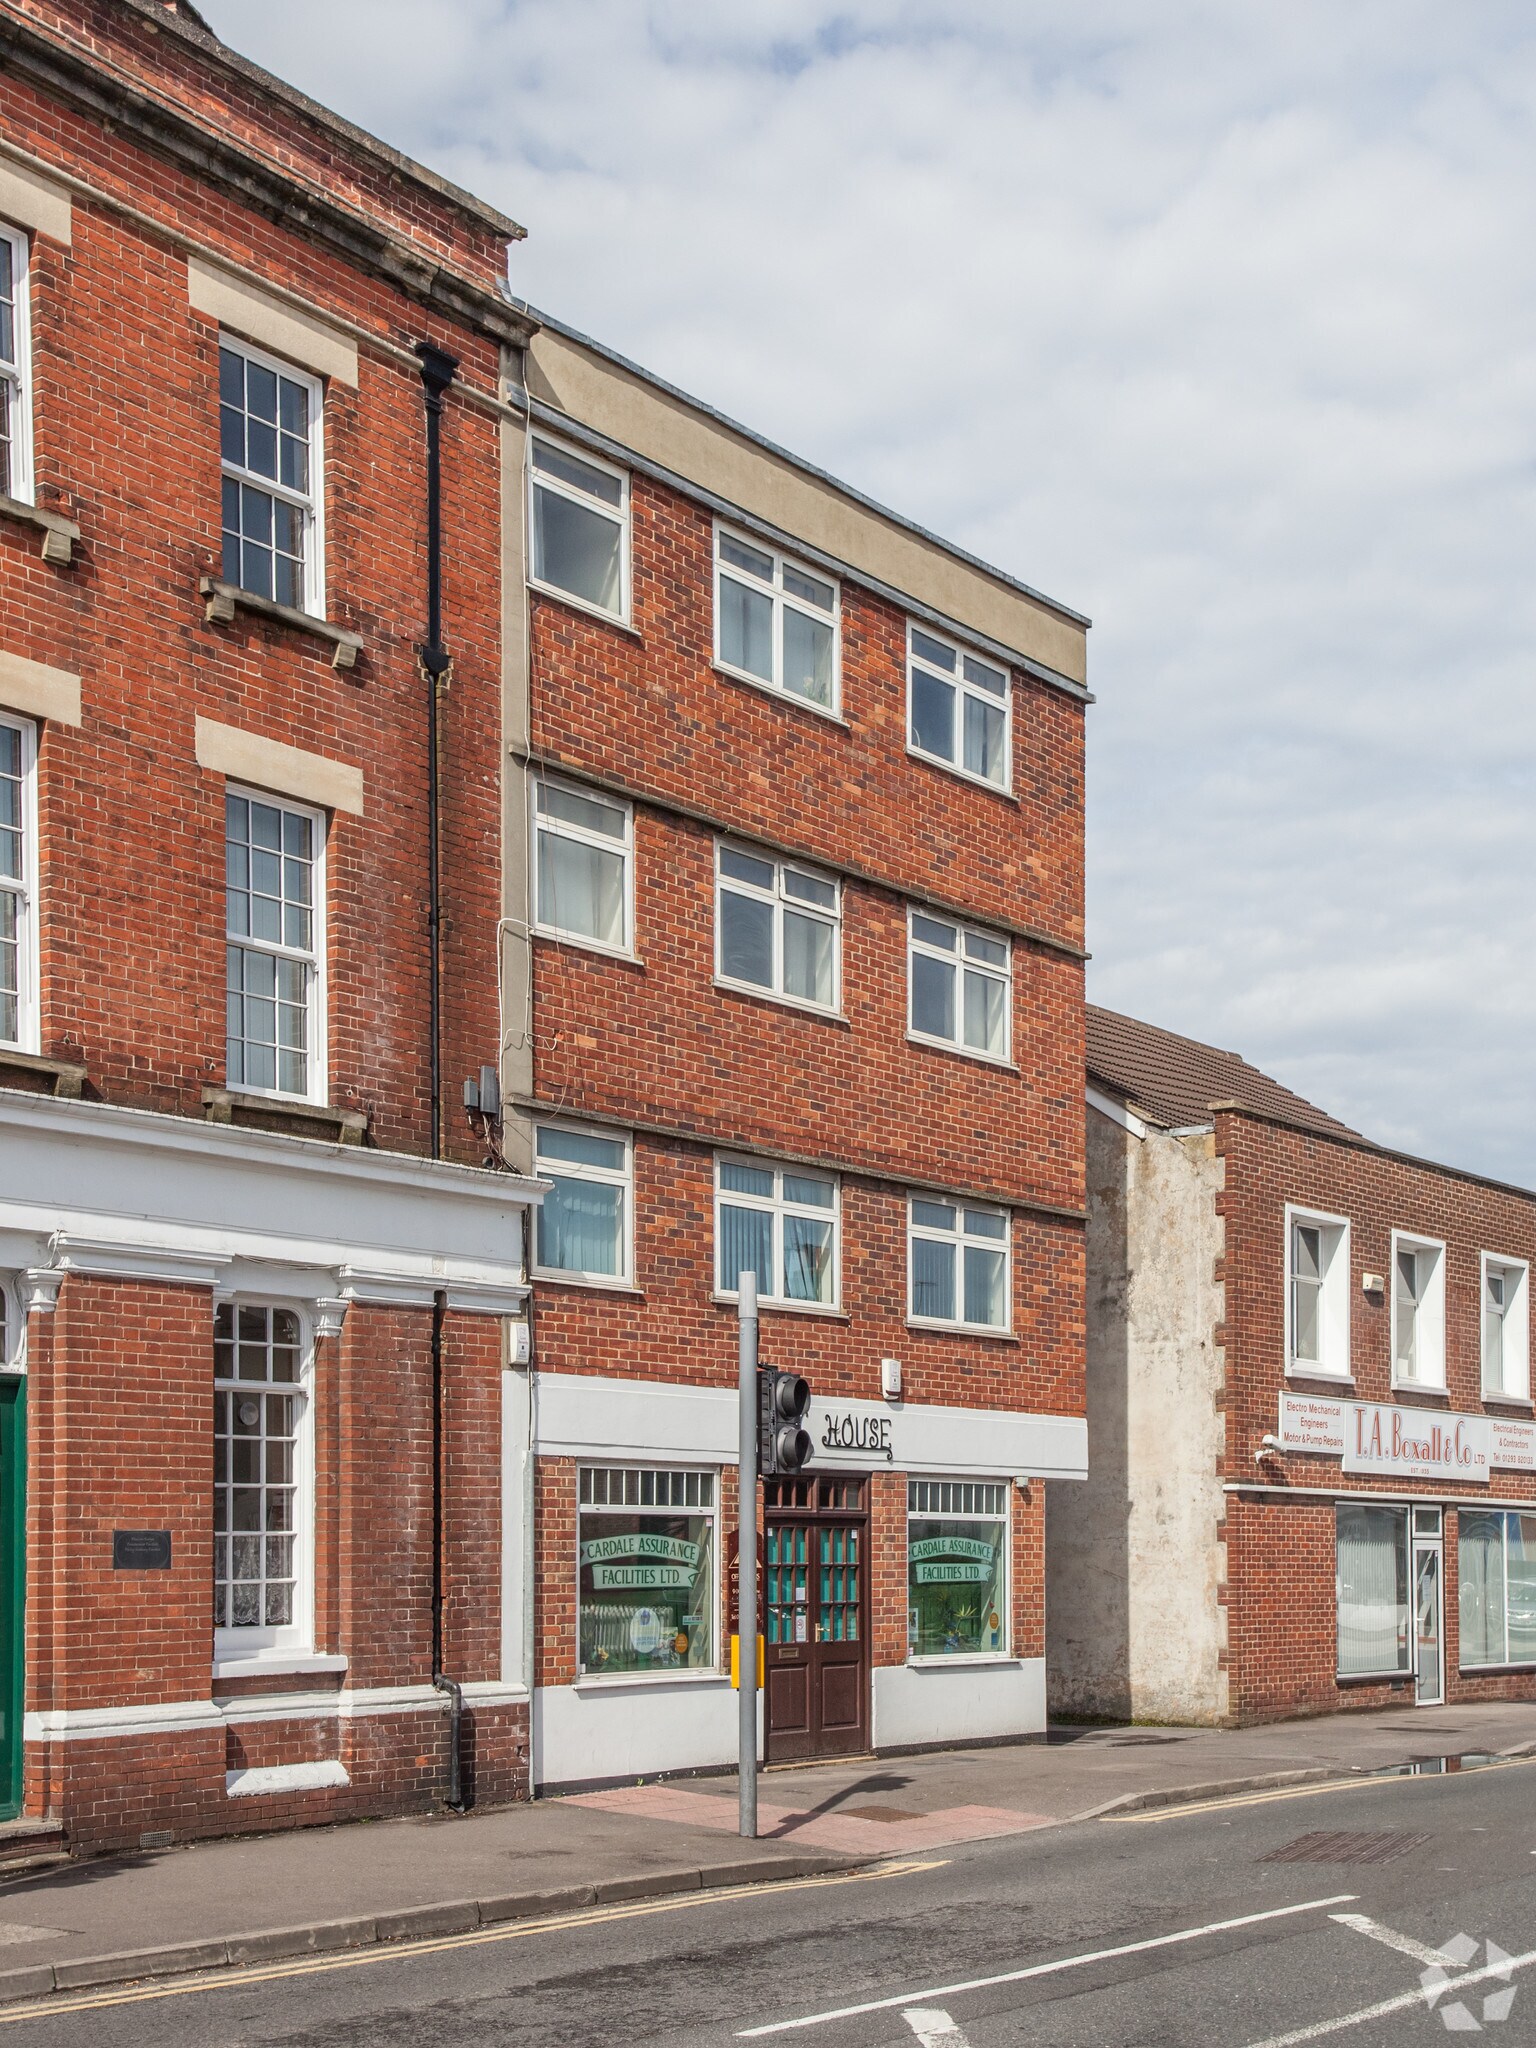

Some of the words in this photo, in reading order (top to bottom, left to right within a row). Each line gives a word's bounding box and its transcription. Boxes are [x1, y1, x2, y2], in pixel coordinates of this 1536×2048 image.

[1286, 1401, 1307, 1413] Electro
[1309, 1404, 1341, 1416] Mechanical
[1300, 1416, 1328, 1430] Engineers
[823, 1413, 892, 1451] HOUSE
[1391, 1411, 1441, 1461] Boxall
[1444, 1437, 1452, 1463] &
[1454, 1419, 1471, 1465] Co
[1474, 1454, 1486, 1464] LTD
[1284, 1432, 1301, 1443] Motor
[1302, 1434, 1306, 1443] &
[1306, 1434, 1323, 1447] Pump
[1323, 1435, 1344, 1448] Repairs
[1503, 1438, 1529, 1449] Contractors
[587, 1538, 634, 1558] CARDALE
[638, 1537, 696, 1560] ASSURANCE
[911, 1540, 946, 1557] CARDALE
[949, 1539, 991, 1558] ASSURANCE
[602, 1569, 656, 1584] FACILITIES
[660, 1569, 681, 1584] LTD.
[922, 1566, 962, 1580] FACILITIES
